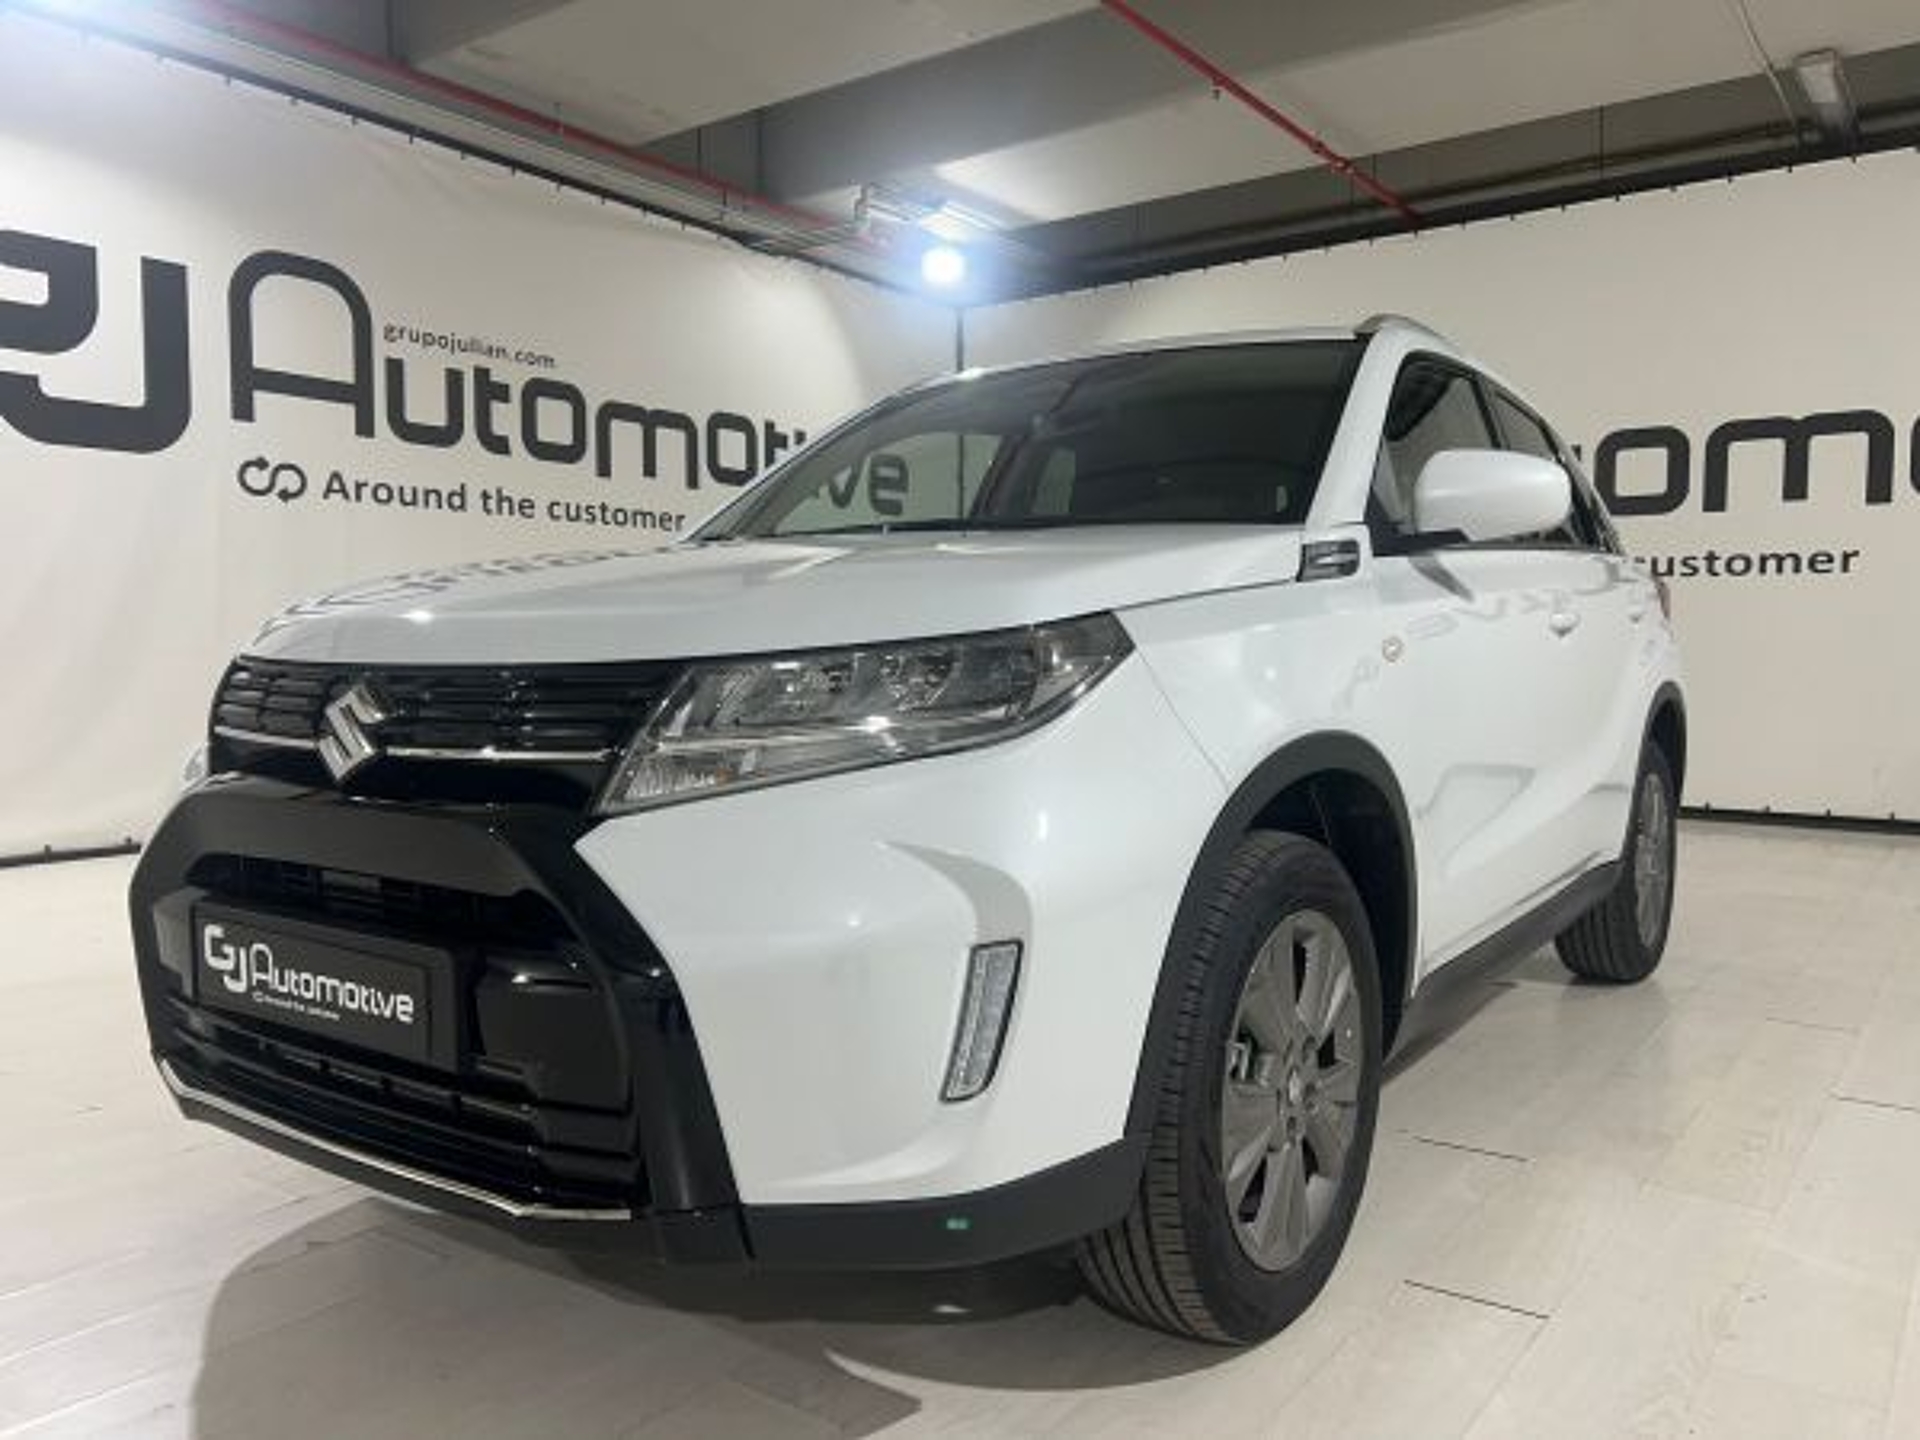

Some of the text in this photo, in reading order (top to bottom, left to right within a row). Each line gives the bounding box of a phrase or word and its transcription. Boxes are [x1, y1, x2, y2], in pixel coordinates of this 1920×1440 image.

[227, 250, 909, 516] Automotve
[322, 470, 685, 532] Around the customer
[1635, 549, 1860, 578] ustomer
[204, 923, 415, 1025] GJ Automotive
